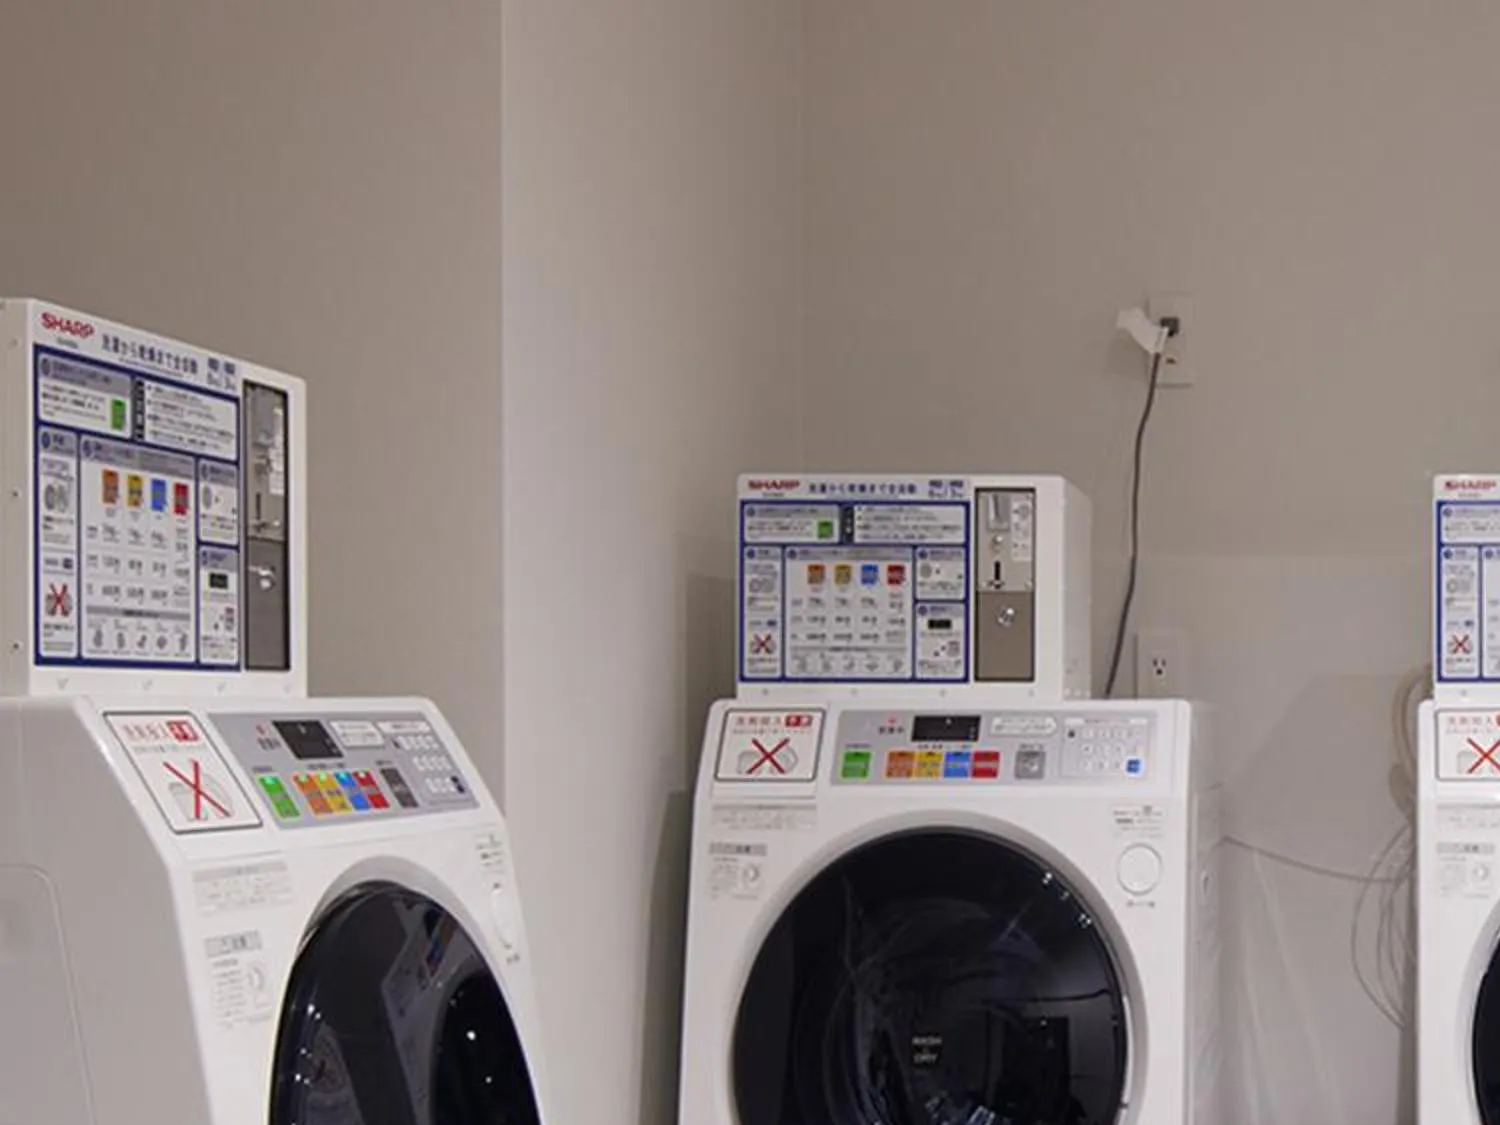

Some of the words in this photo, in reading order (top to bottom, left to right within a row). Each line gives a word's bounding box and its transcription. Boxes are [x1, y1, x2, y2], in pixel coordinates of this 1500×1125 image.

[40, 311, 95, 338] SHARP
[748, 479, 801, 490] SHARP
[1443, 480, 1497, 491] SHARP
